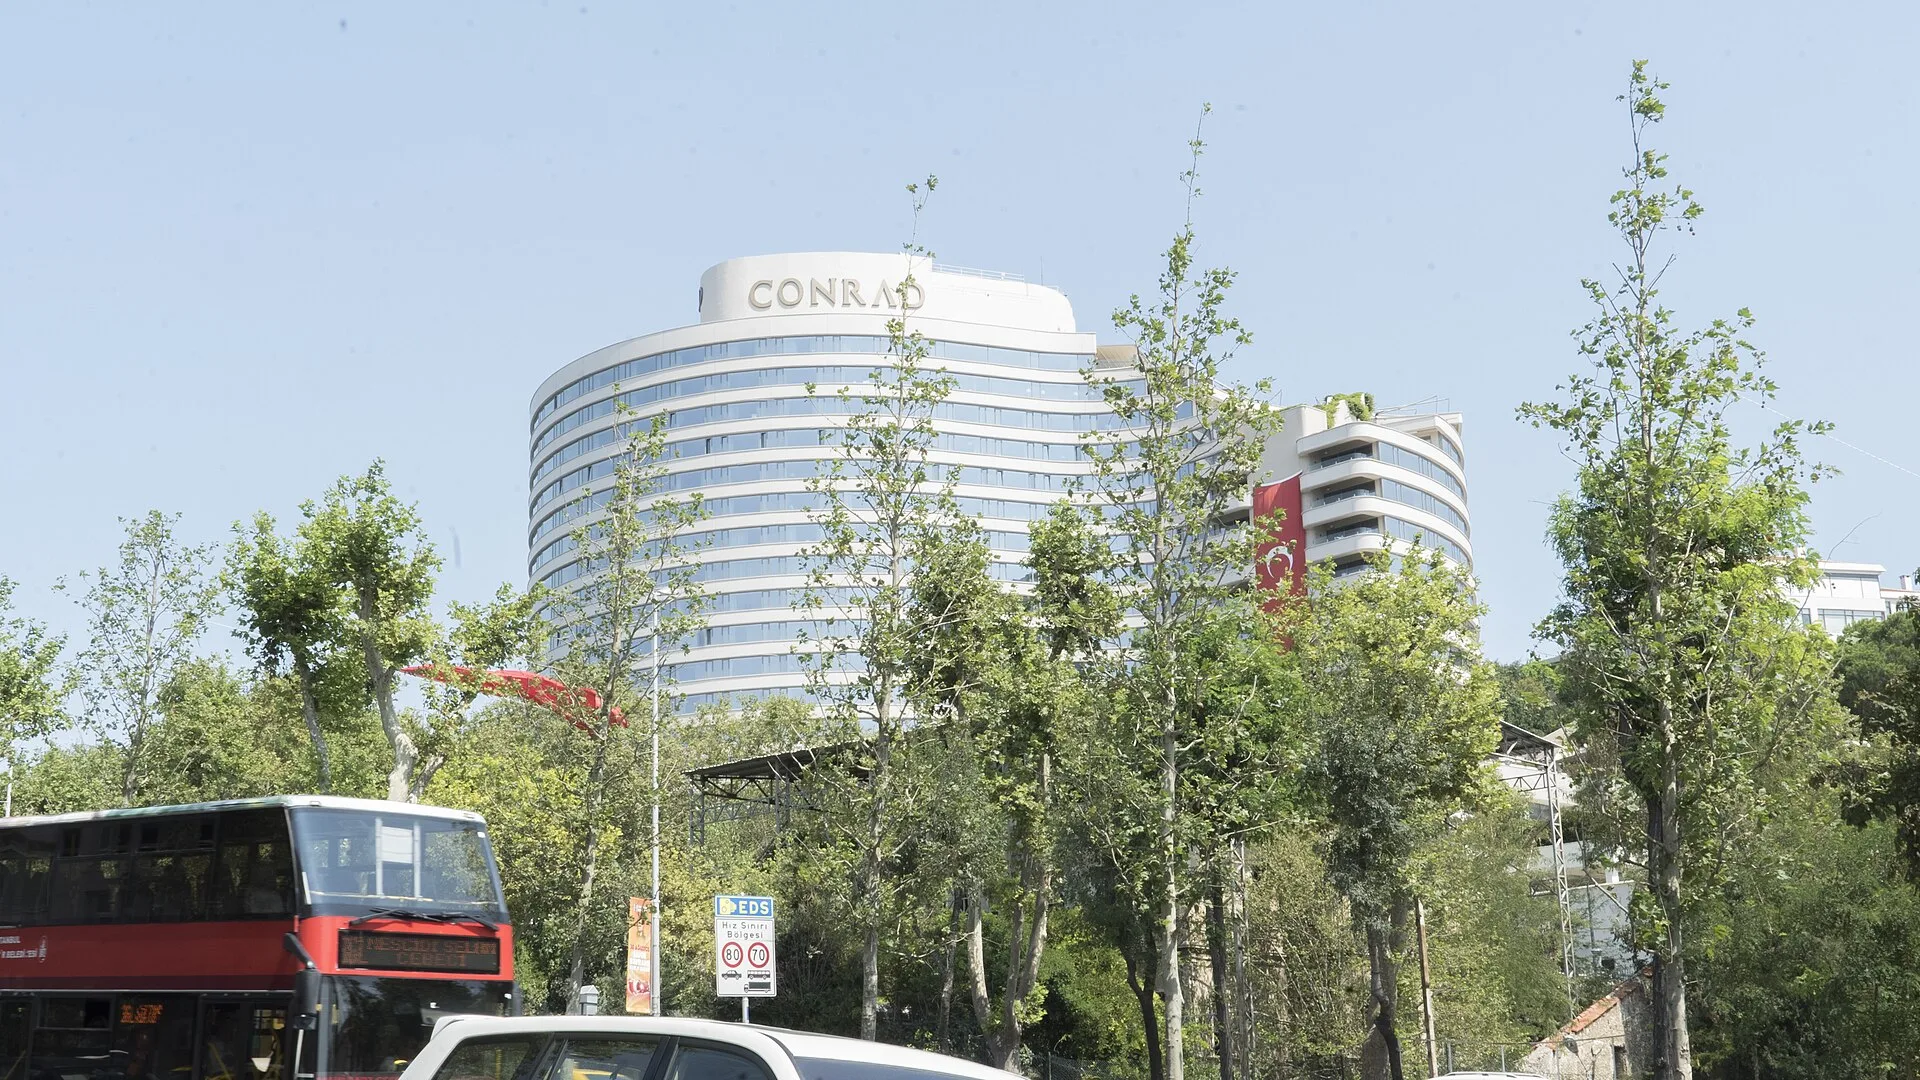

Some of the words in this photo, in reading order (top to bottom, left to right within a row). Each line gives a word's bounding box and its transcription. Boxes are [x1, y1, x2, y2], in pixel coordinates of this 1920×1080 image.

[748, 278, 926, 310] CONRAD
[738, 900, 769, 915] EDS
[727, 931, 763, 940] Bölgesi
[726, 949, 740, 961] 80
[752, 949, 765, 961] 70
